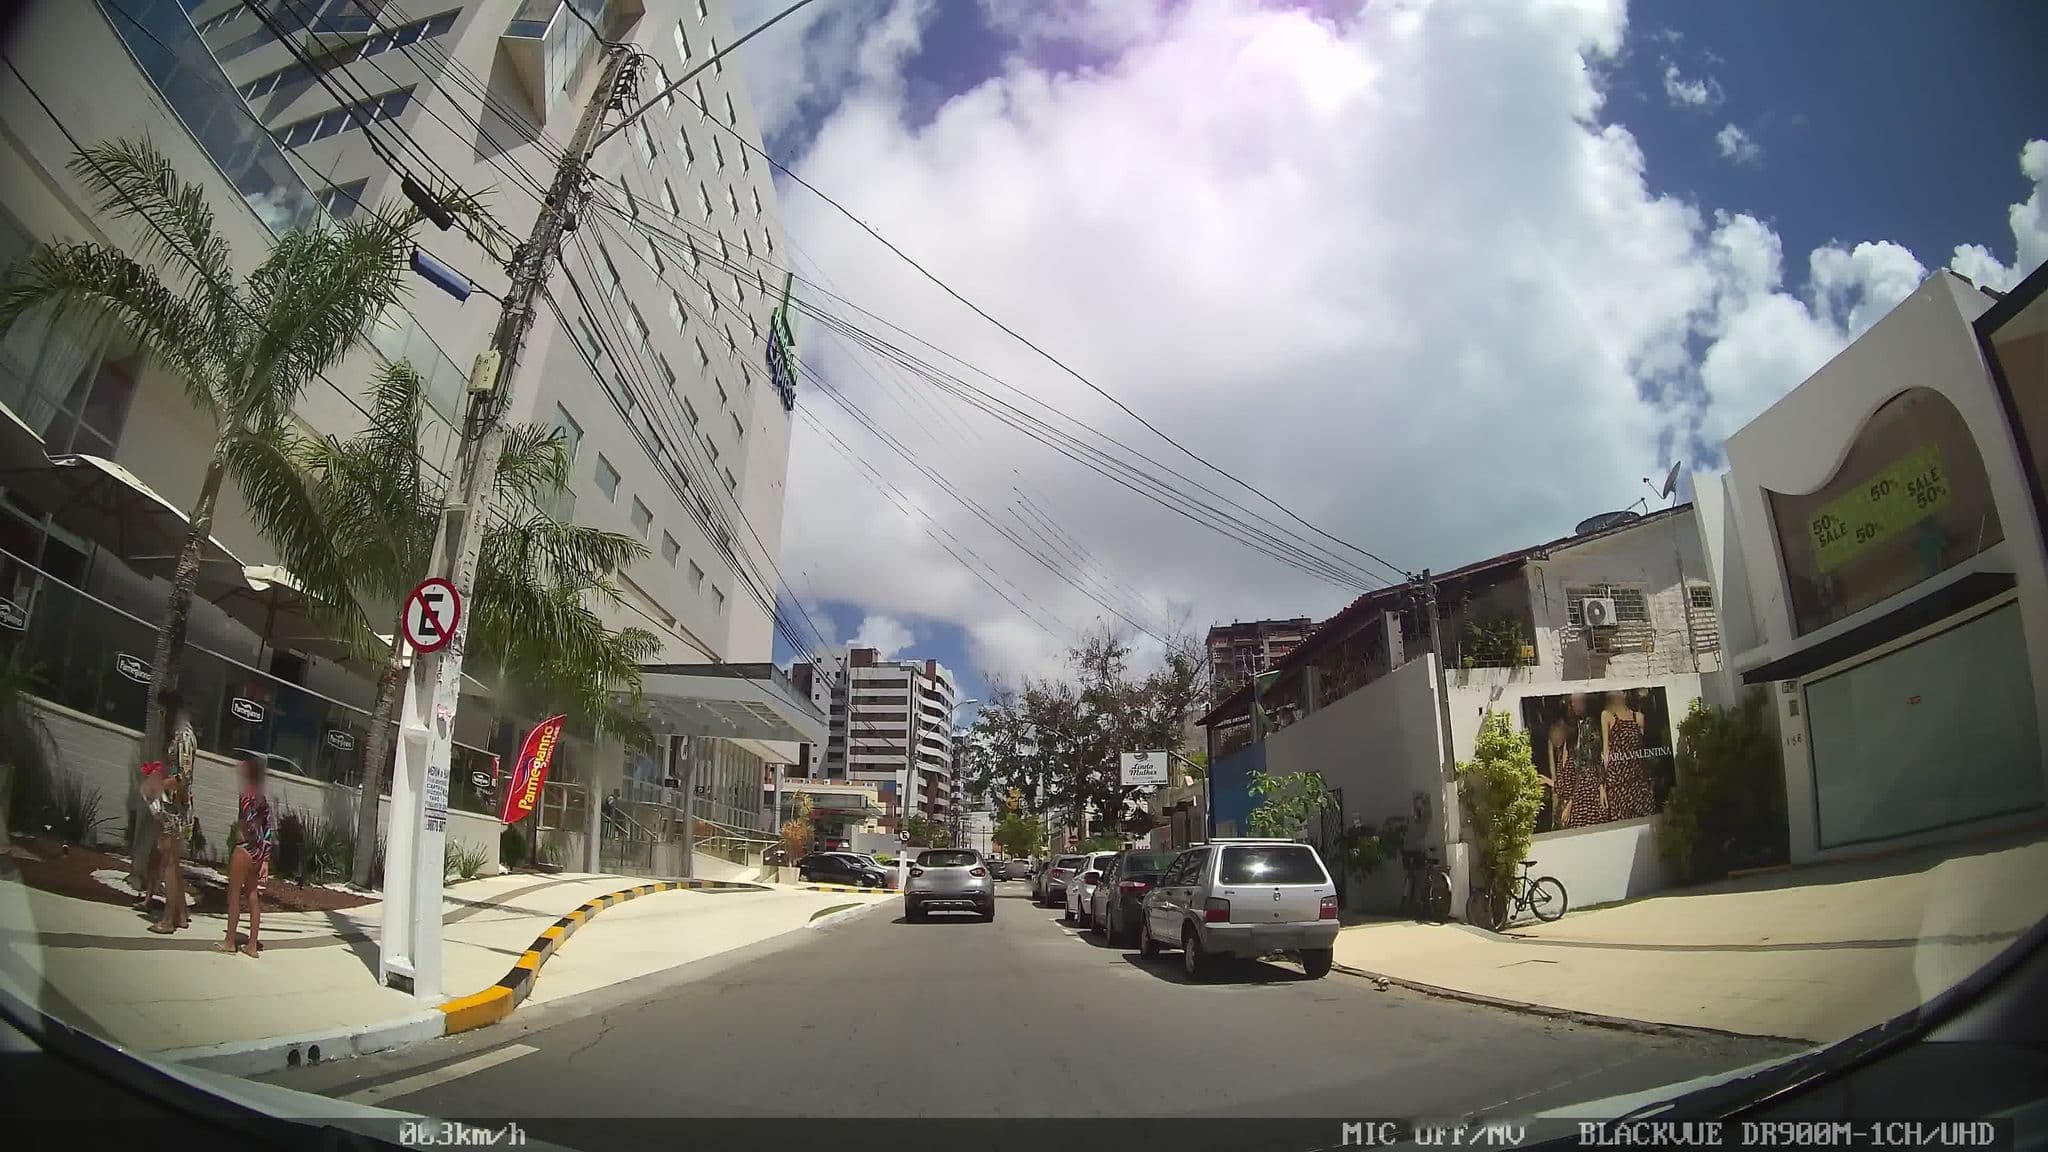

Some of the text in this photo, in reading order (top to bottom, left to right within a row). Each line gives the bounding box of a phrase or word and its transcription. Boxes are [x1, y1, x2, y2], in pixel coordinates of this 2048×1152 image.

[1906, 467, 1939, 497] SALE
[1819, 522, 1848, 548] SALE
[418, 594, 443, 635] E
